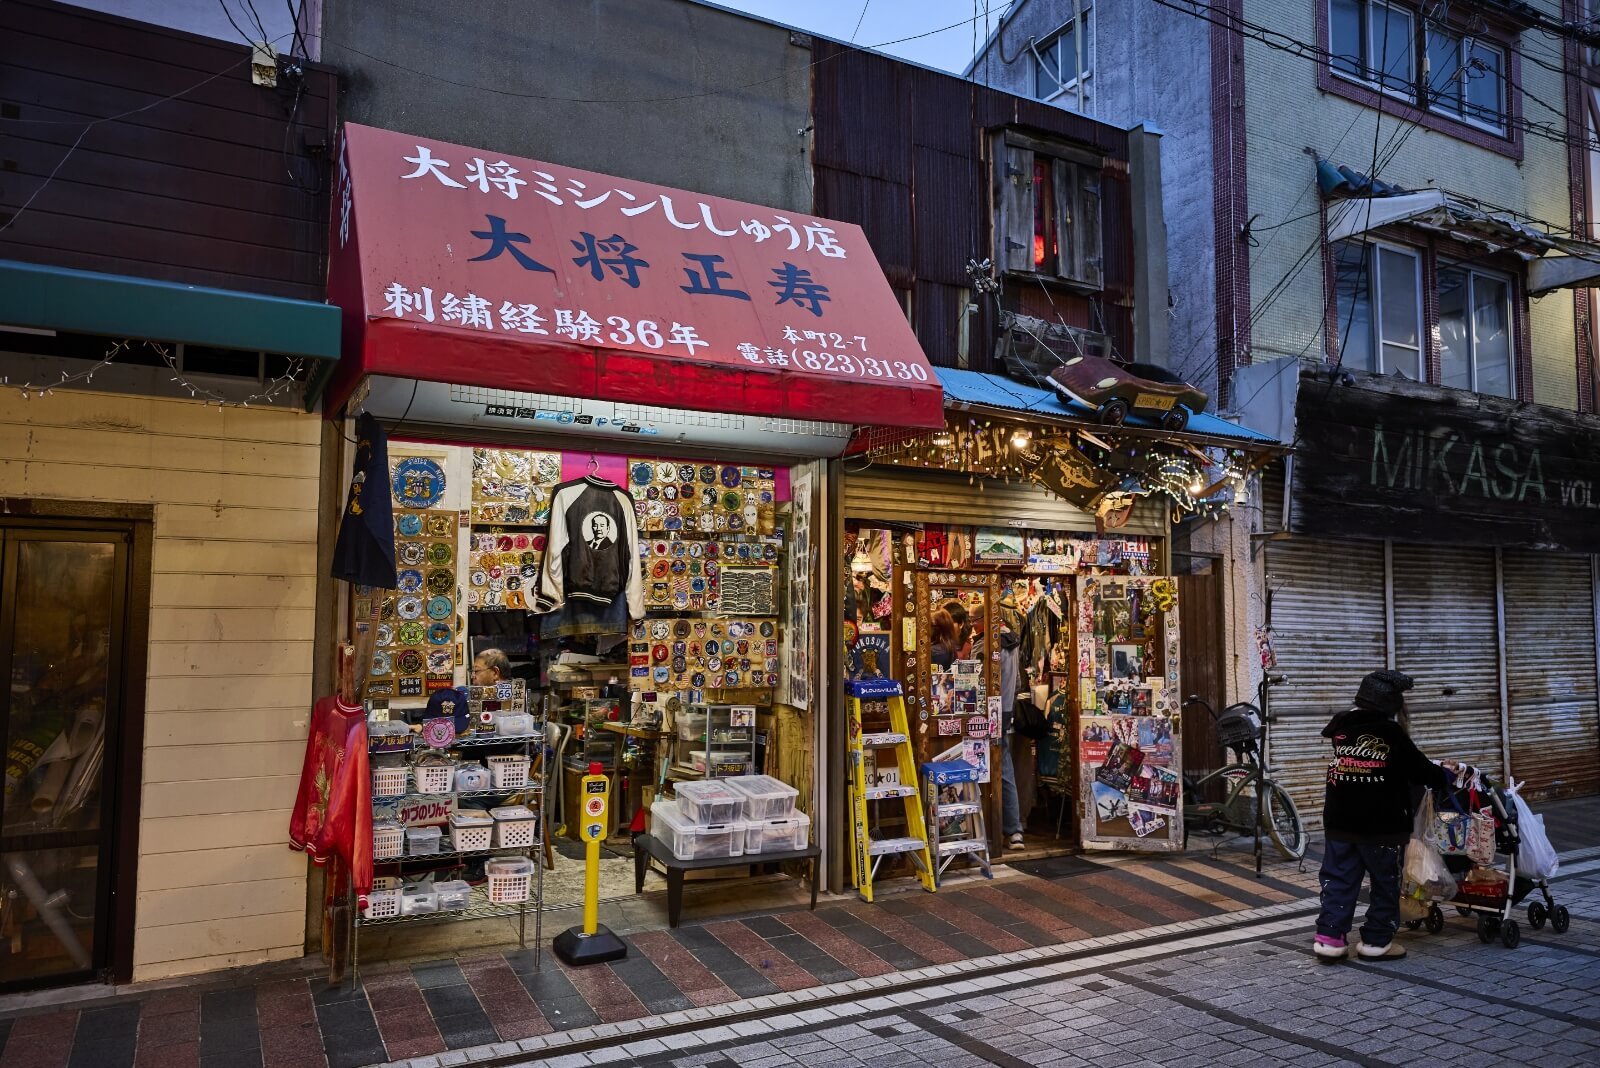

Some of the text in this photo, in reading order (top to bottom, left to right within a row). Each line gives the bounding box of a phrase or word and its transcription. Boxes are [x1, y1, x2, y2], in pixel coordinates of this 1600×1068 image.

[401, 145, 847, 259] 大将ミシンししゅう店
[468, 214, 831, 317] 大将正寿
[384, 282, 709, 356] 刺繍経験36年
[782, 325, 869, 352] 本町2-7
[736, 342, 928, 384] 電話(823)3130
[1370, 422, 1546, 503] MIKASA
[917, 536, 948, 551] SALE
[499, 690, 511, 699] 66
